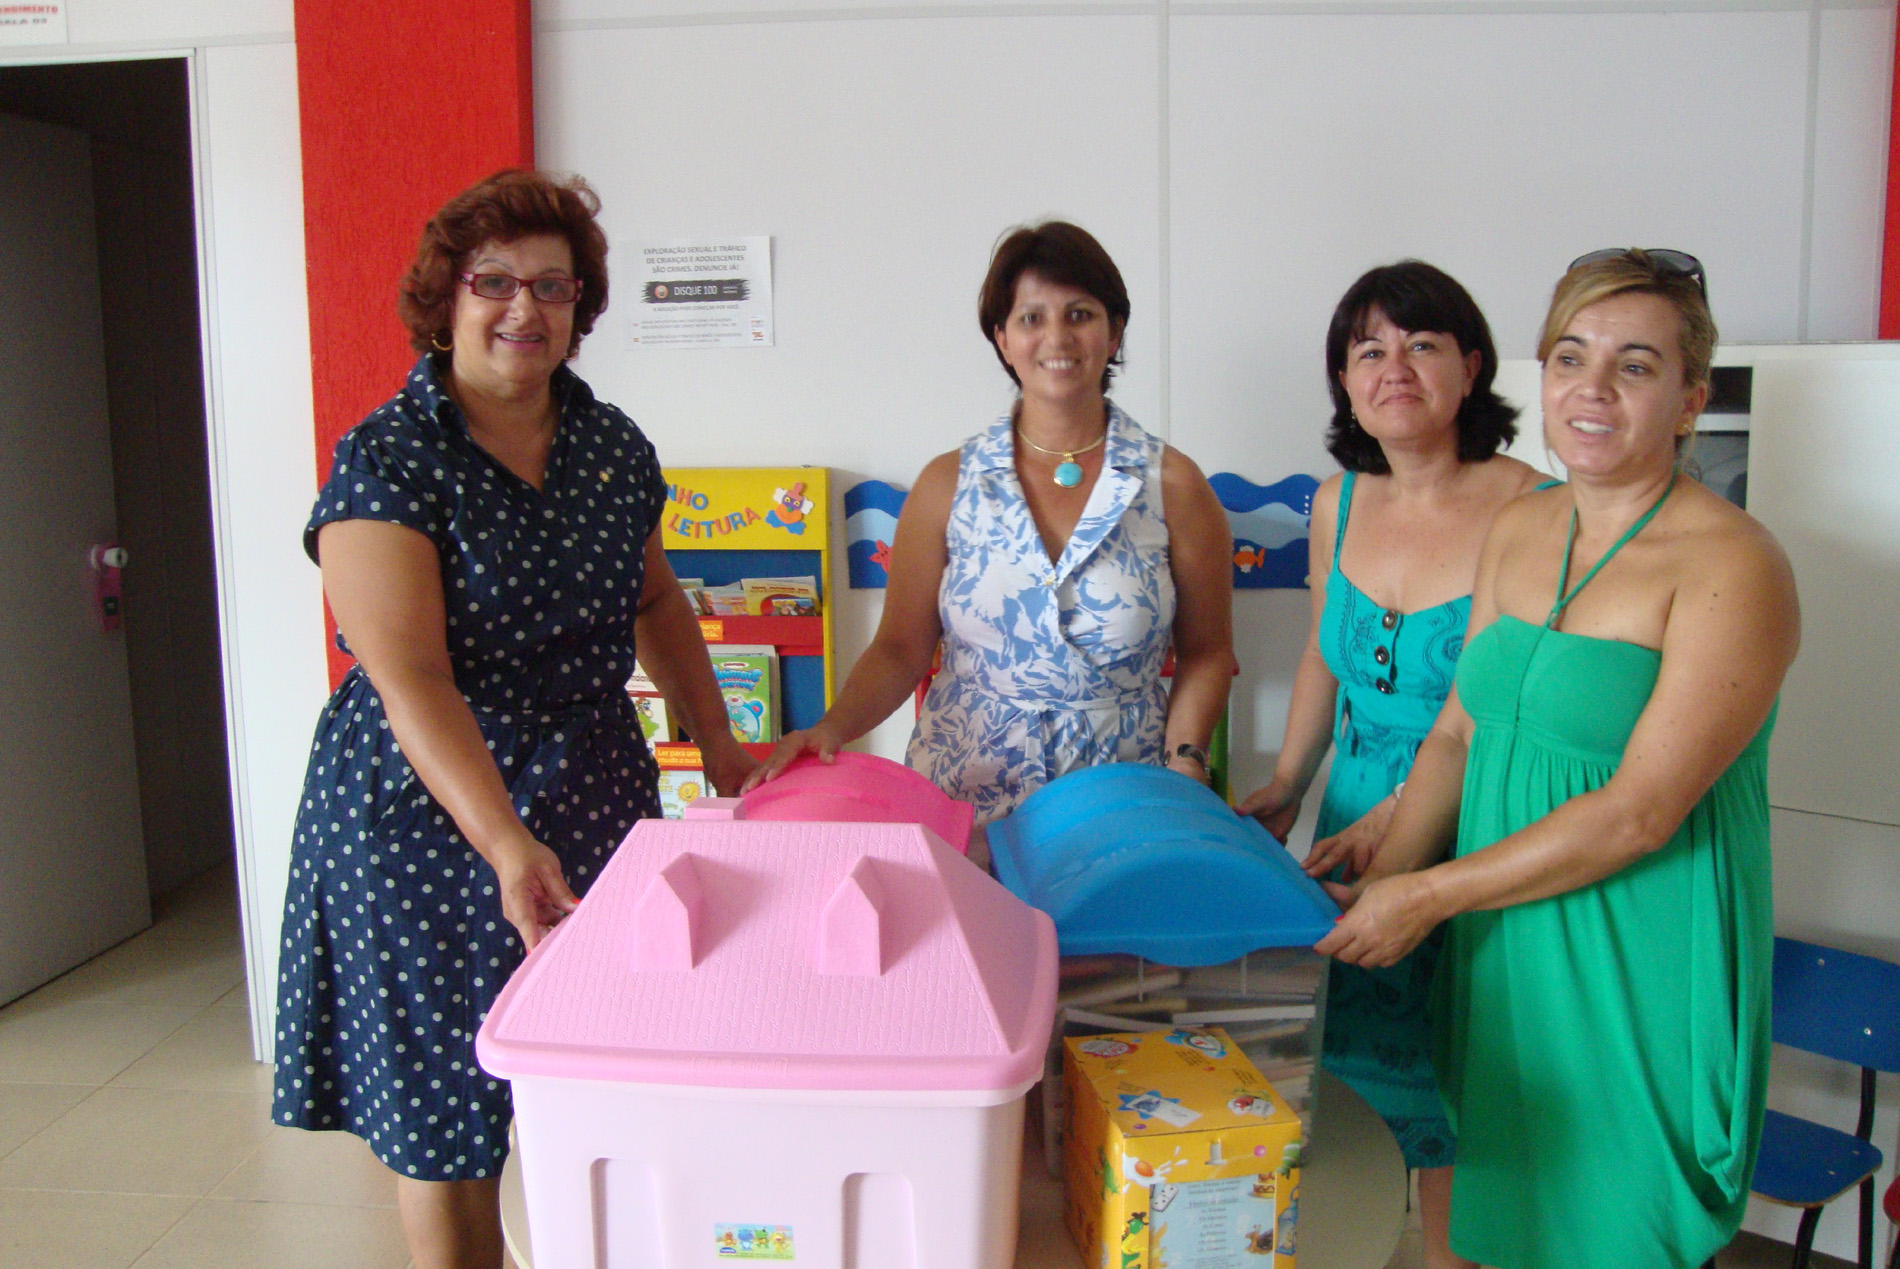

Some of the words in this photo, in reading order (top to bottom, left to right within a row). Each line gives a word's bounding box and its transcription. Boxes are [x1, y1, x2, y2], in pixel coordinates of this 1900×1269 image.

[643, 246, 686, 255] EXPLORAÇÃO
[719, 244, 747, 252] TRÁFICO
[656, 256, 688, 264] CRIANÇAS
[652, 265, 666, 273] SÃO
[673, 286, 702, 296] DISQUE
[703, 285, 717, 295] 100
[667, 507, 761, 539] LEITURA
[669, 750, 686, 758] para
